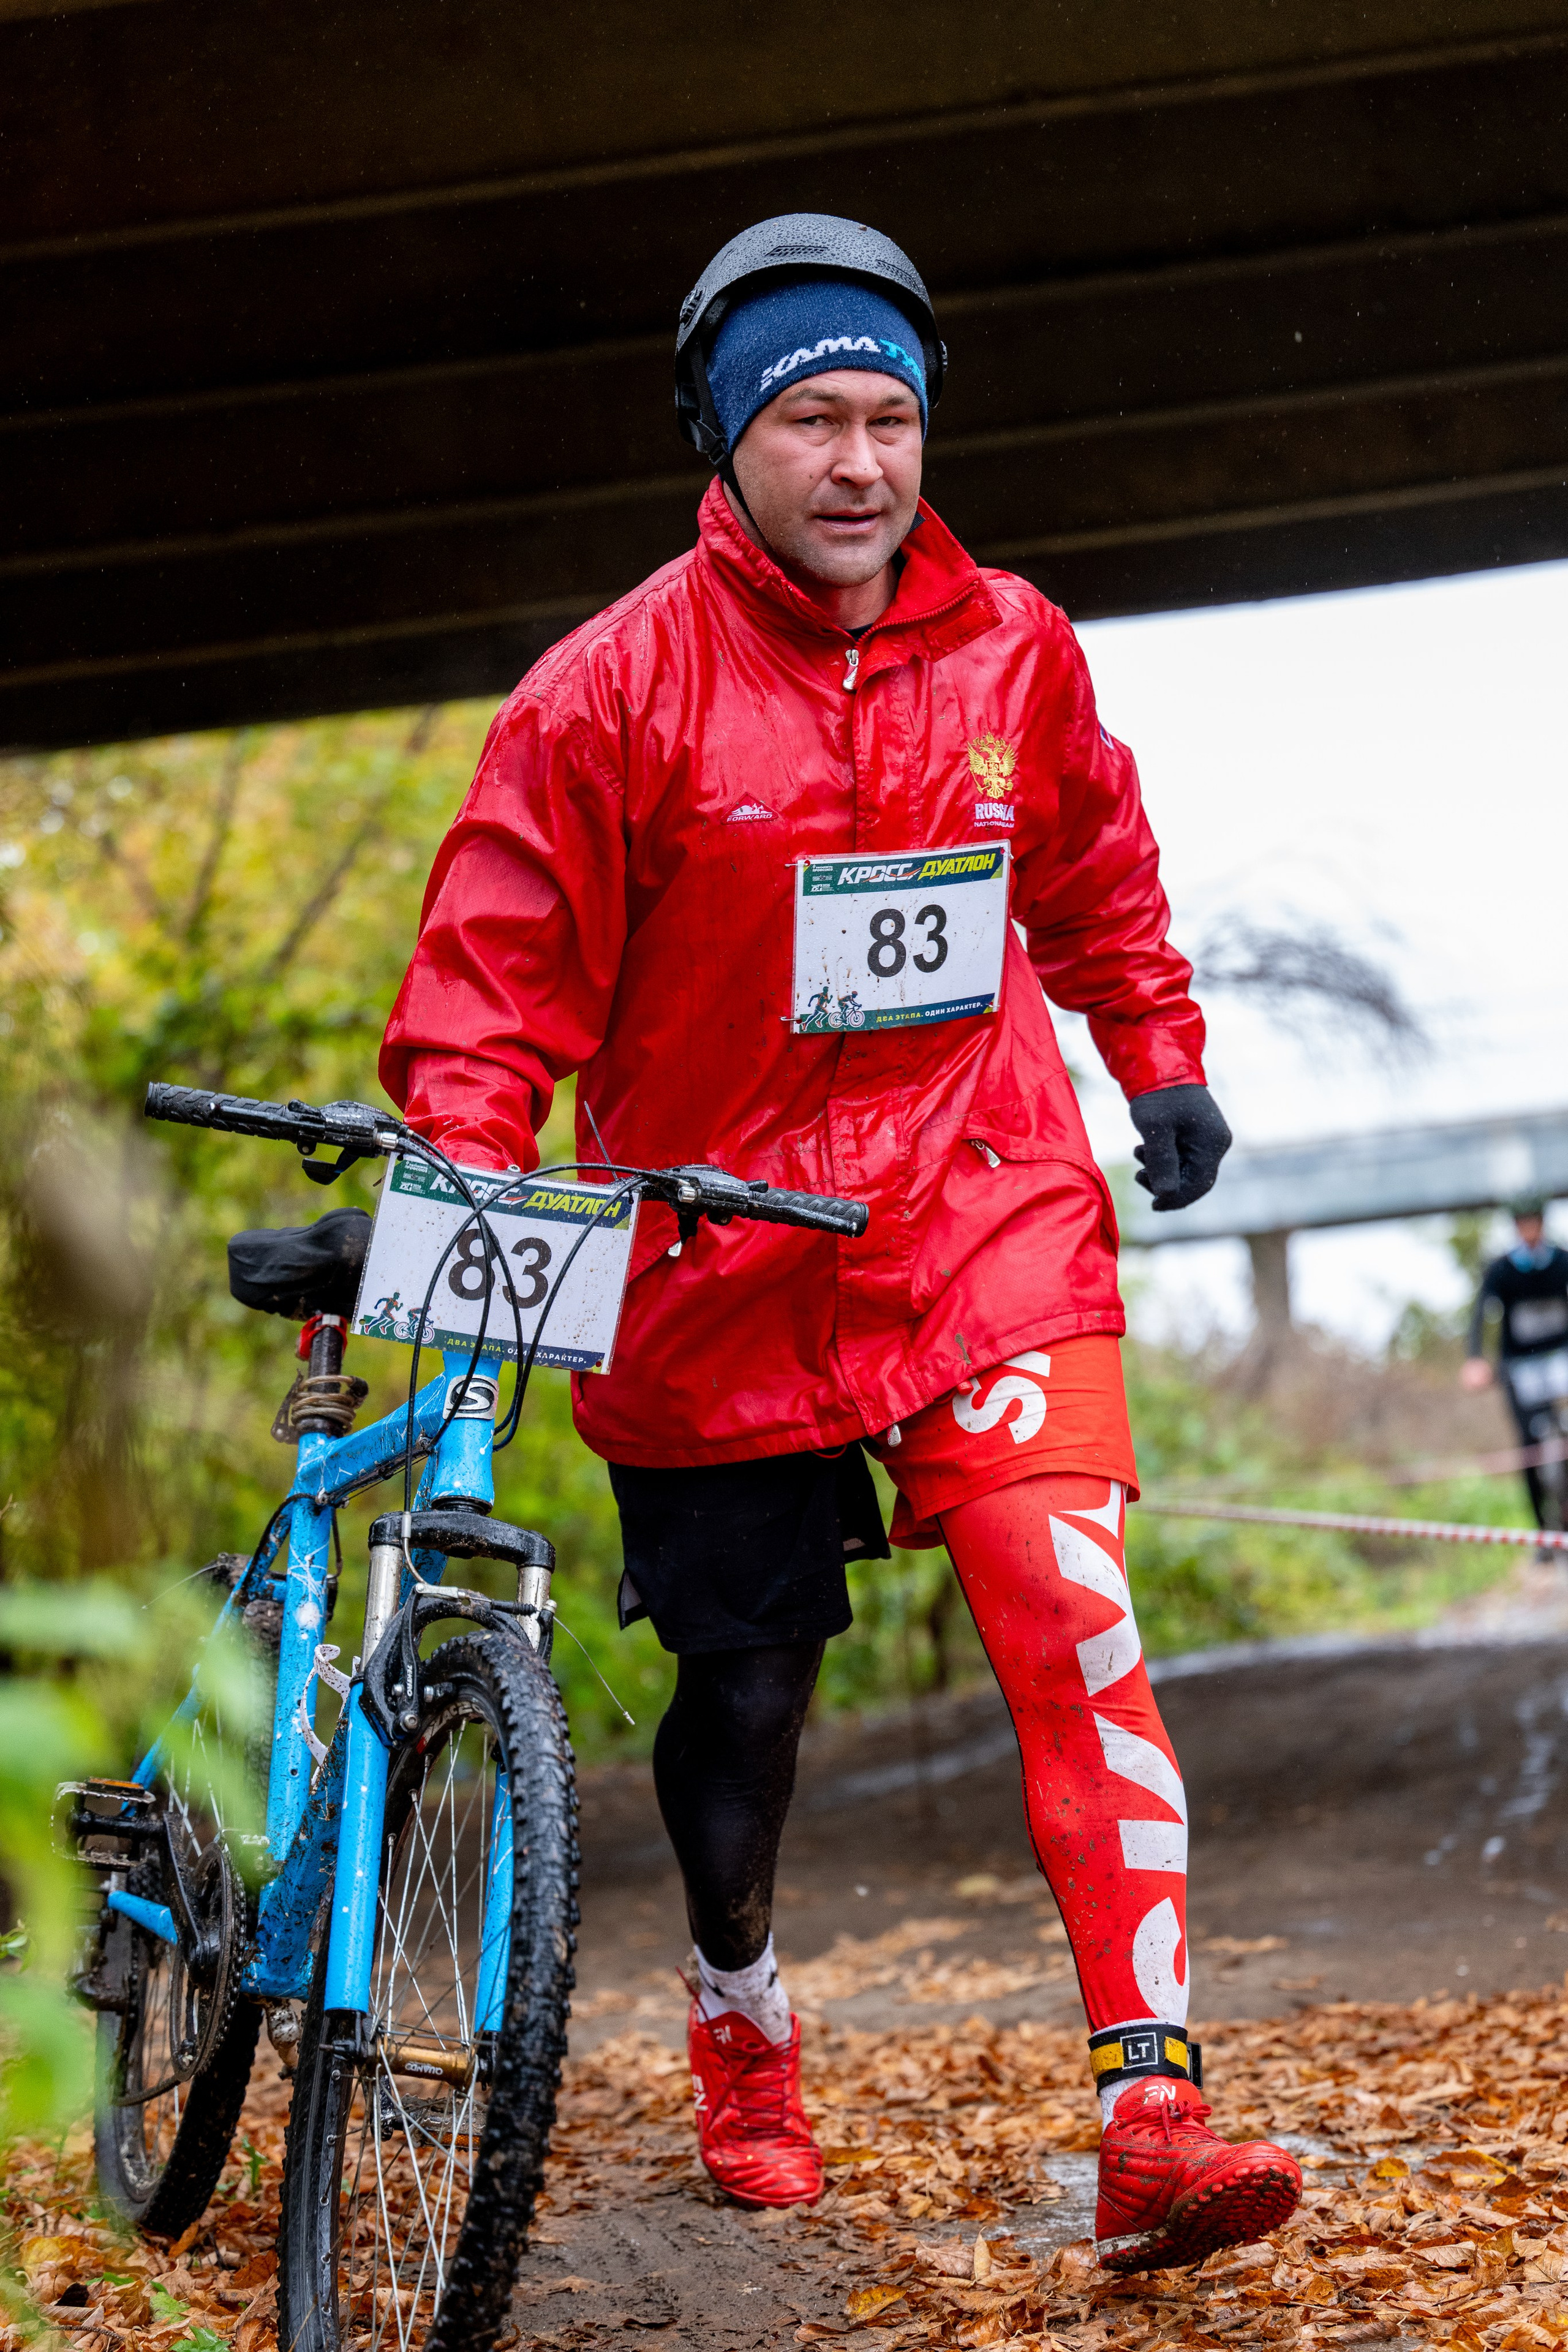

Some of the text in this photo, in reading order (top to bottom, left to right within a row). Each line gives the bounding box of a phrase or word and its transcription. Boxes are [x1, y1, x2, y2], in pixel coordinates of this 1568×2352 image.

[974, 802, 1015, 821] RUSSIA
[837, 853, 996, 885] КРОСС ДУАТЛОН
[867, 904, 948, 978] 83
[876, 1001, 983, 1023] ДВА ЭТАПА. ОДИН ХАРАКТЕР.
[522, 1190, 622, 1218] ДУАТЛОН
[448, 1228, 552, 1309] 83
[447, 1338, 587, 1364] ДВА ЭАПА. ОДИ ХАРАКТЕР.
[1128, 2042, 1150, 2060] LT
[404, 2062, 443, 2076] QUANDO
[1144, 2084, 1176, 2105] FN
